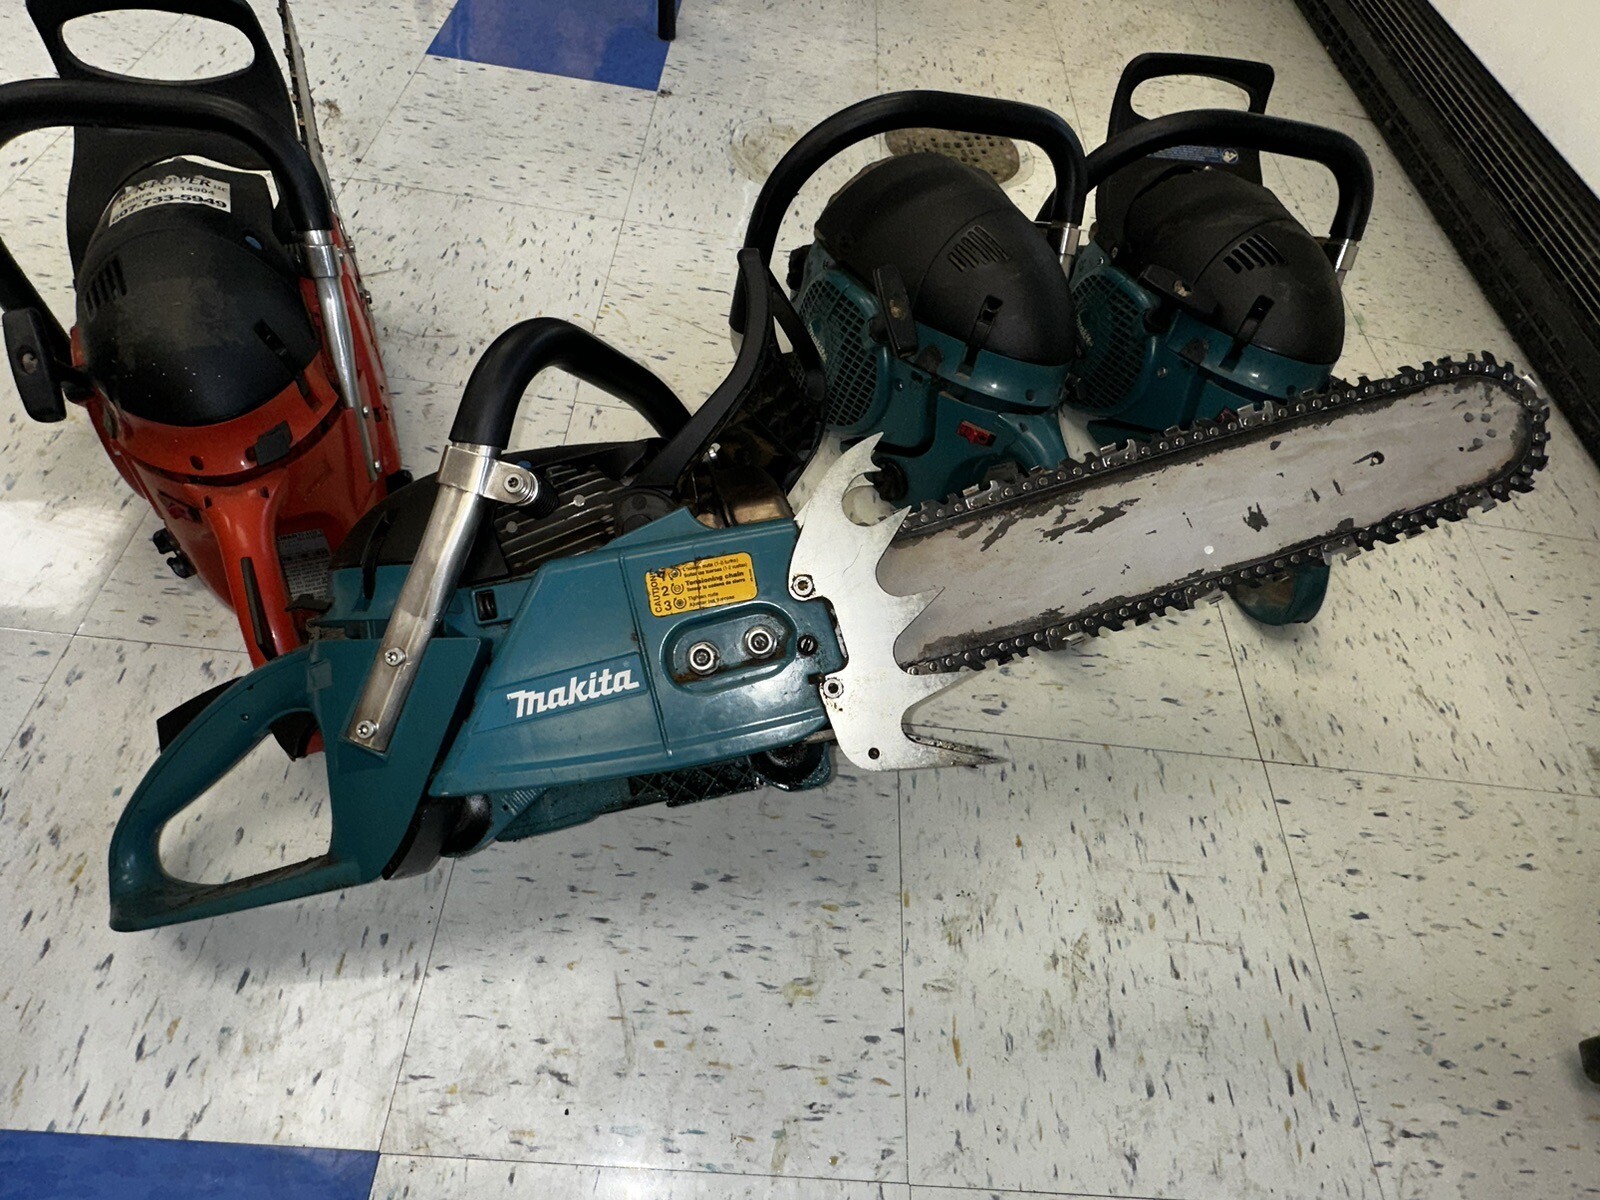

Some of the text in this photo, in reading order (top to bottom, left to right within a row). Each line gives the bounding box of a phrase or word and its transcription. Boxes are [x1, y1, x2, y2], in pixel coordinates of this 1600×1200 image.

[180, 186, 215, 195] 14904
[685, 575, 723, 586] Tensioning
[725, 571, 744, 579] chain
[661, 585, 670, 597] 2
[663, 600, 672, 611] 3
